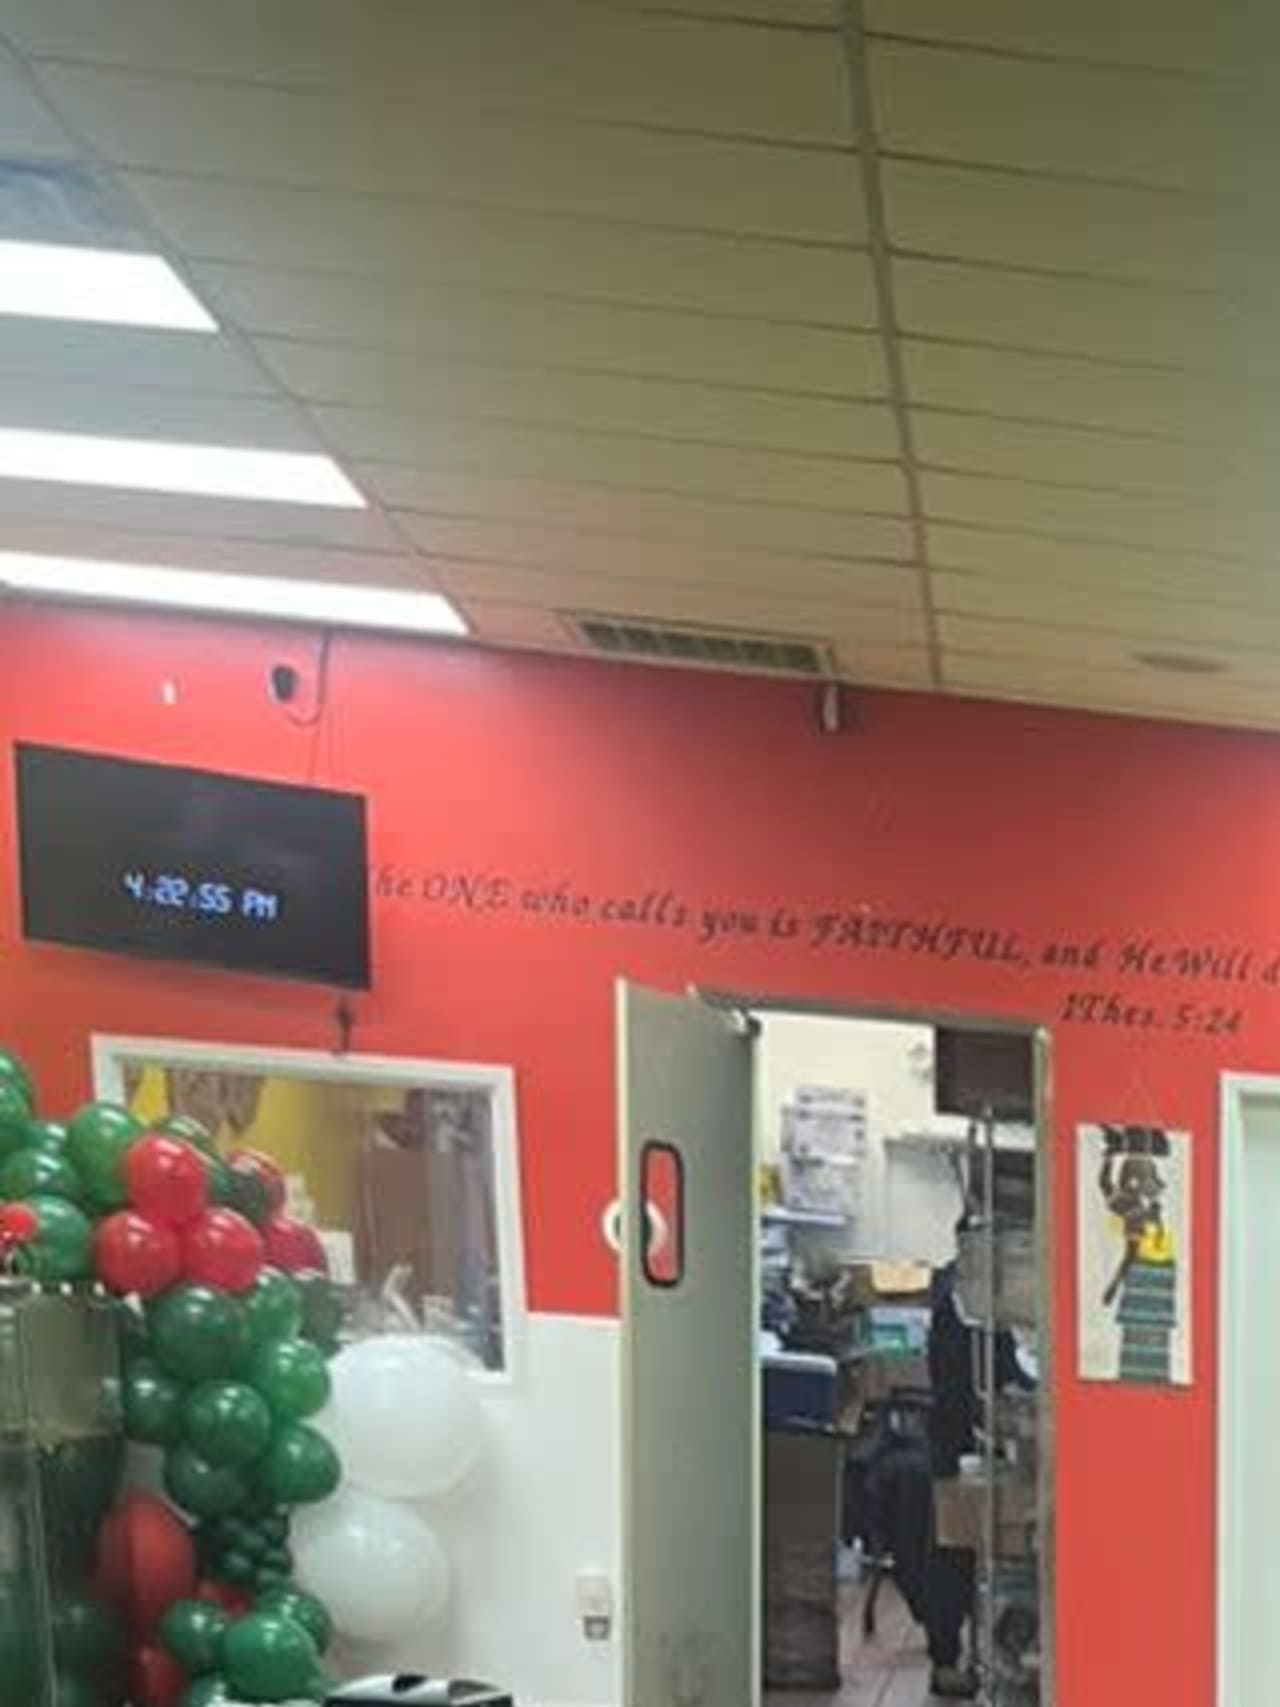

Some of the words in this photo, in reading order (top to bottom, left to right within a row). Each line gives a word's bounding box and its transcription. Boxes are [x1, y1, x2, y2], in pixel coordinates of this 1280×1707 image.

[243, 888, 278, 921] PM
[368, 860, 411, 899] he
[422, 873, 513, 910] ONE
[519, 883, 590, 918] who
[599, 888, 688, 930] calls
[698, 911, 761, 943] you
[769, 907, 798, 939] is
[812, 908, 1035, 970] FAITHFUL,
[1041, 939, 1104, 972] and
